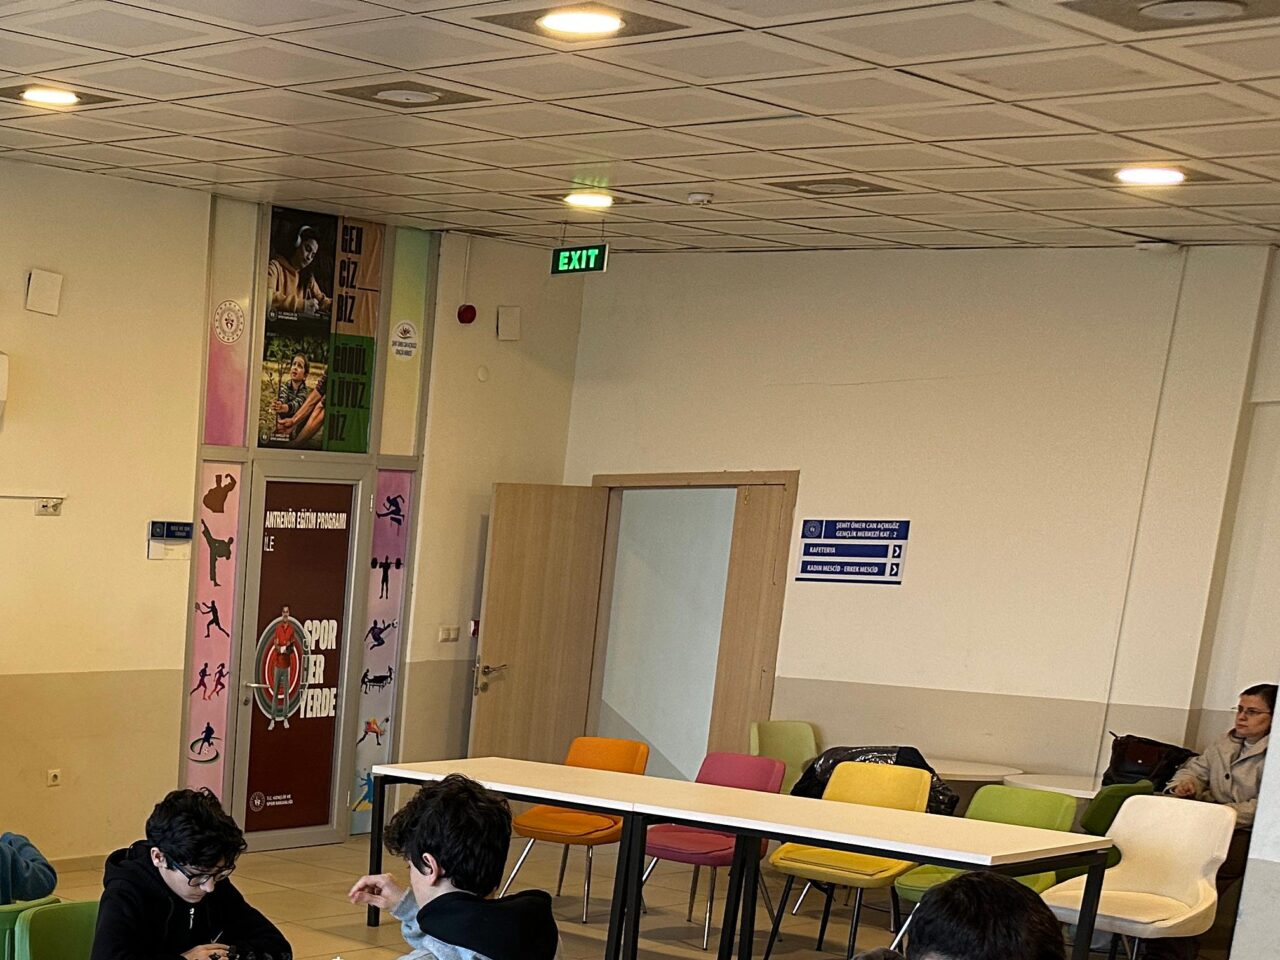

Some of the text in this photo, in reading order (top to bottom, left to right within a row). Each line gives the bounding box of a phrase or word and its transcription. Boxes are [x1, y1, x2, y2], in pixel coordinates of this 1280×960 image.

[558, 249, 598, 270] EXIT
[303, 620, 338, 650] SPOR
[300, 654, 325, 684] HER
[300, 688, 336, 718] YERDE
